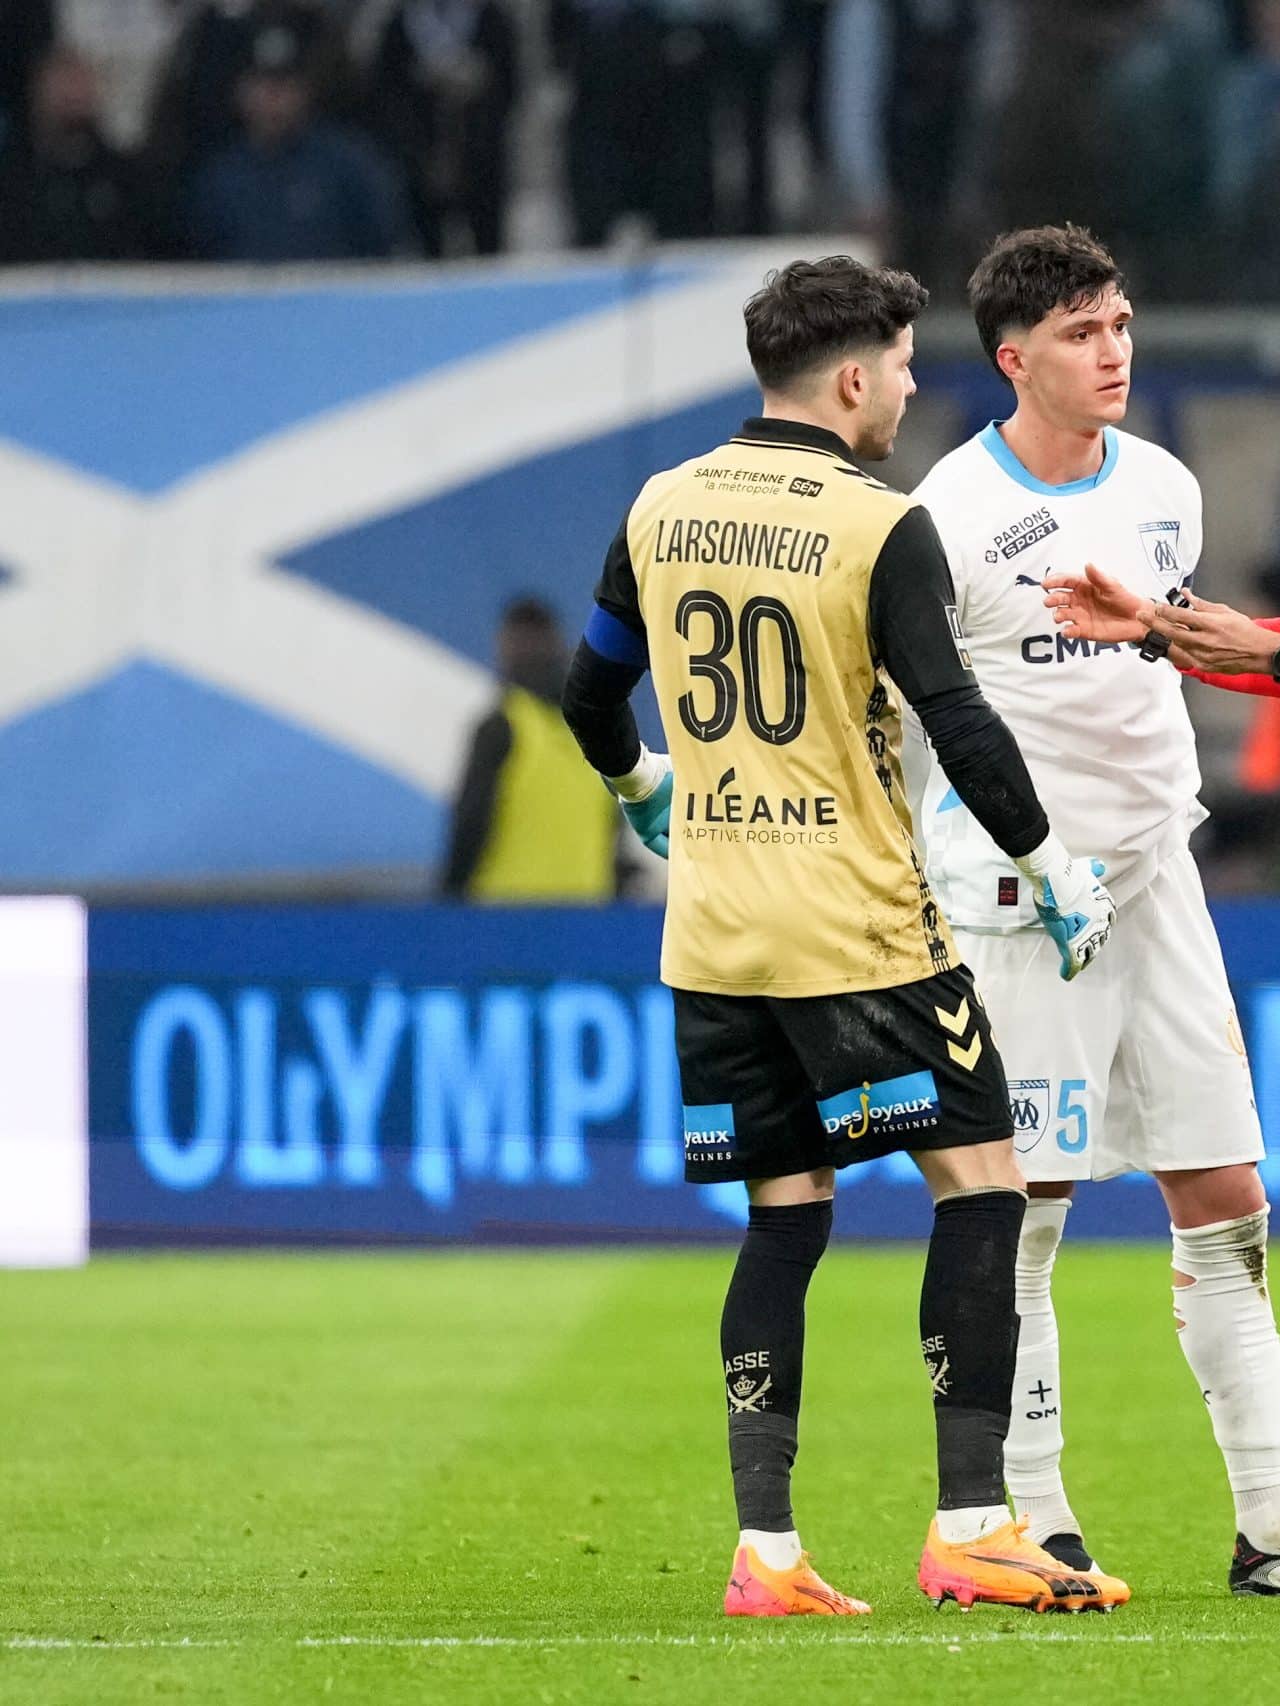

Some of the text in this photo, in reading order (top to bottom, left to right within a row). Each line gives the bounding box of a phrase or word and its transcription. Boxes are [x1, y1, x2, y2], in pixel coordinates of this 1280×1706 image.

[694, 468, 787, 484] SAINT-ÉTIENNE
[704, 480, 781, 496] la métropole
[993, 506, 1051, 549] PARIONS
[1004, 520, 1057, 558] SPORT
[655, 519, 830, 577] LARSONNEUR
[675, 589, 807, 746] 30
[686, 766, 839, 826] ILÉANE
[682, 827, 840, 846] APTIVE ROBOTICS
[132, 975, 748, 1220] OLYMPI
[873, 1117, 938, 1134] PISCINES
[1056, 1079, 1088, 1155] 5
[684, 1129, 730, 1150] yaux
[921, 1335, 946, 1354] SSE
[725, 1351, 770, 1376] ASSE
[1026, 1407, 1058, 1420] OM
